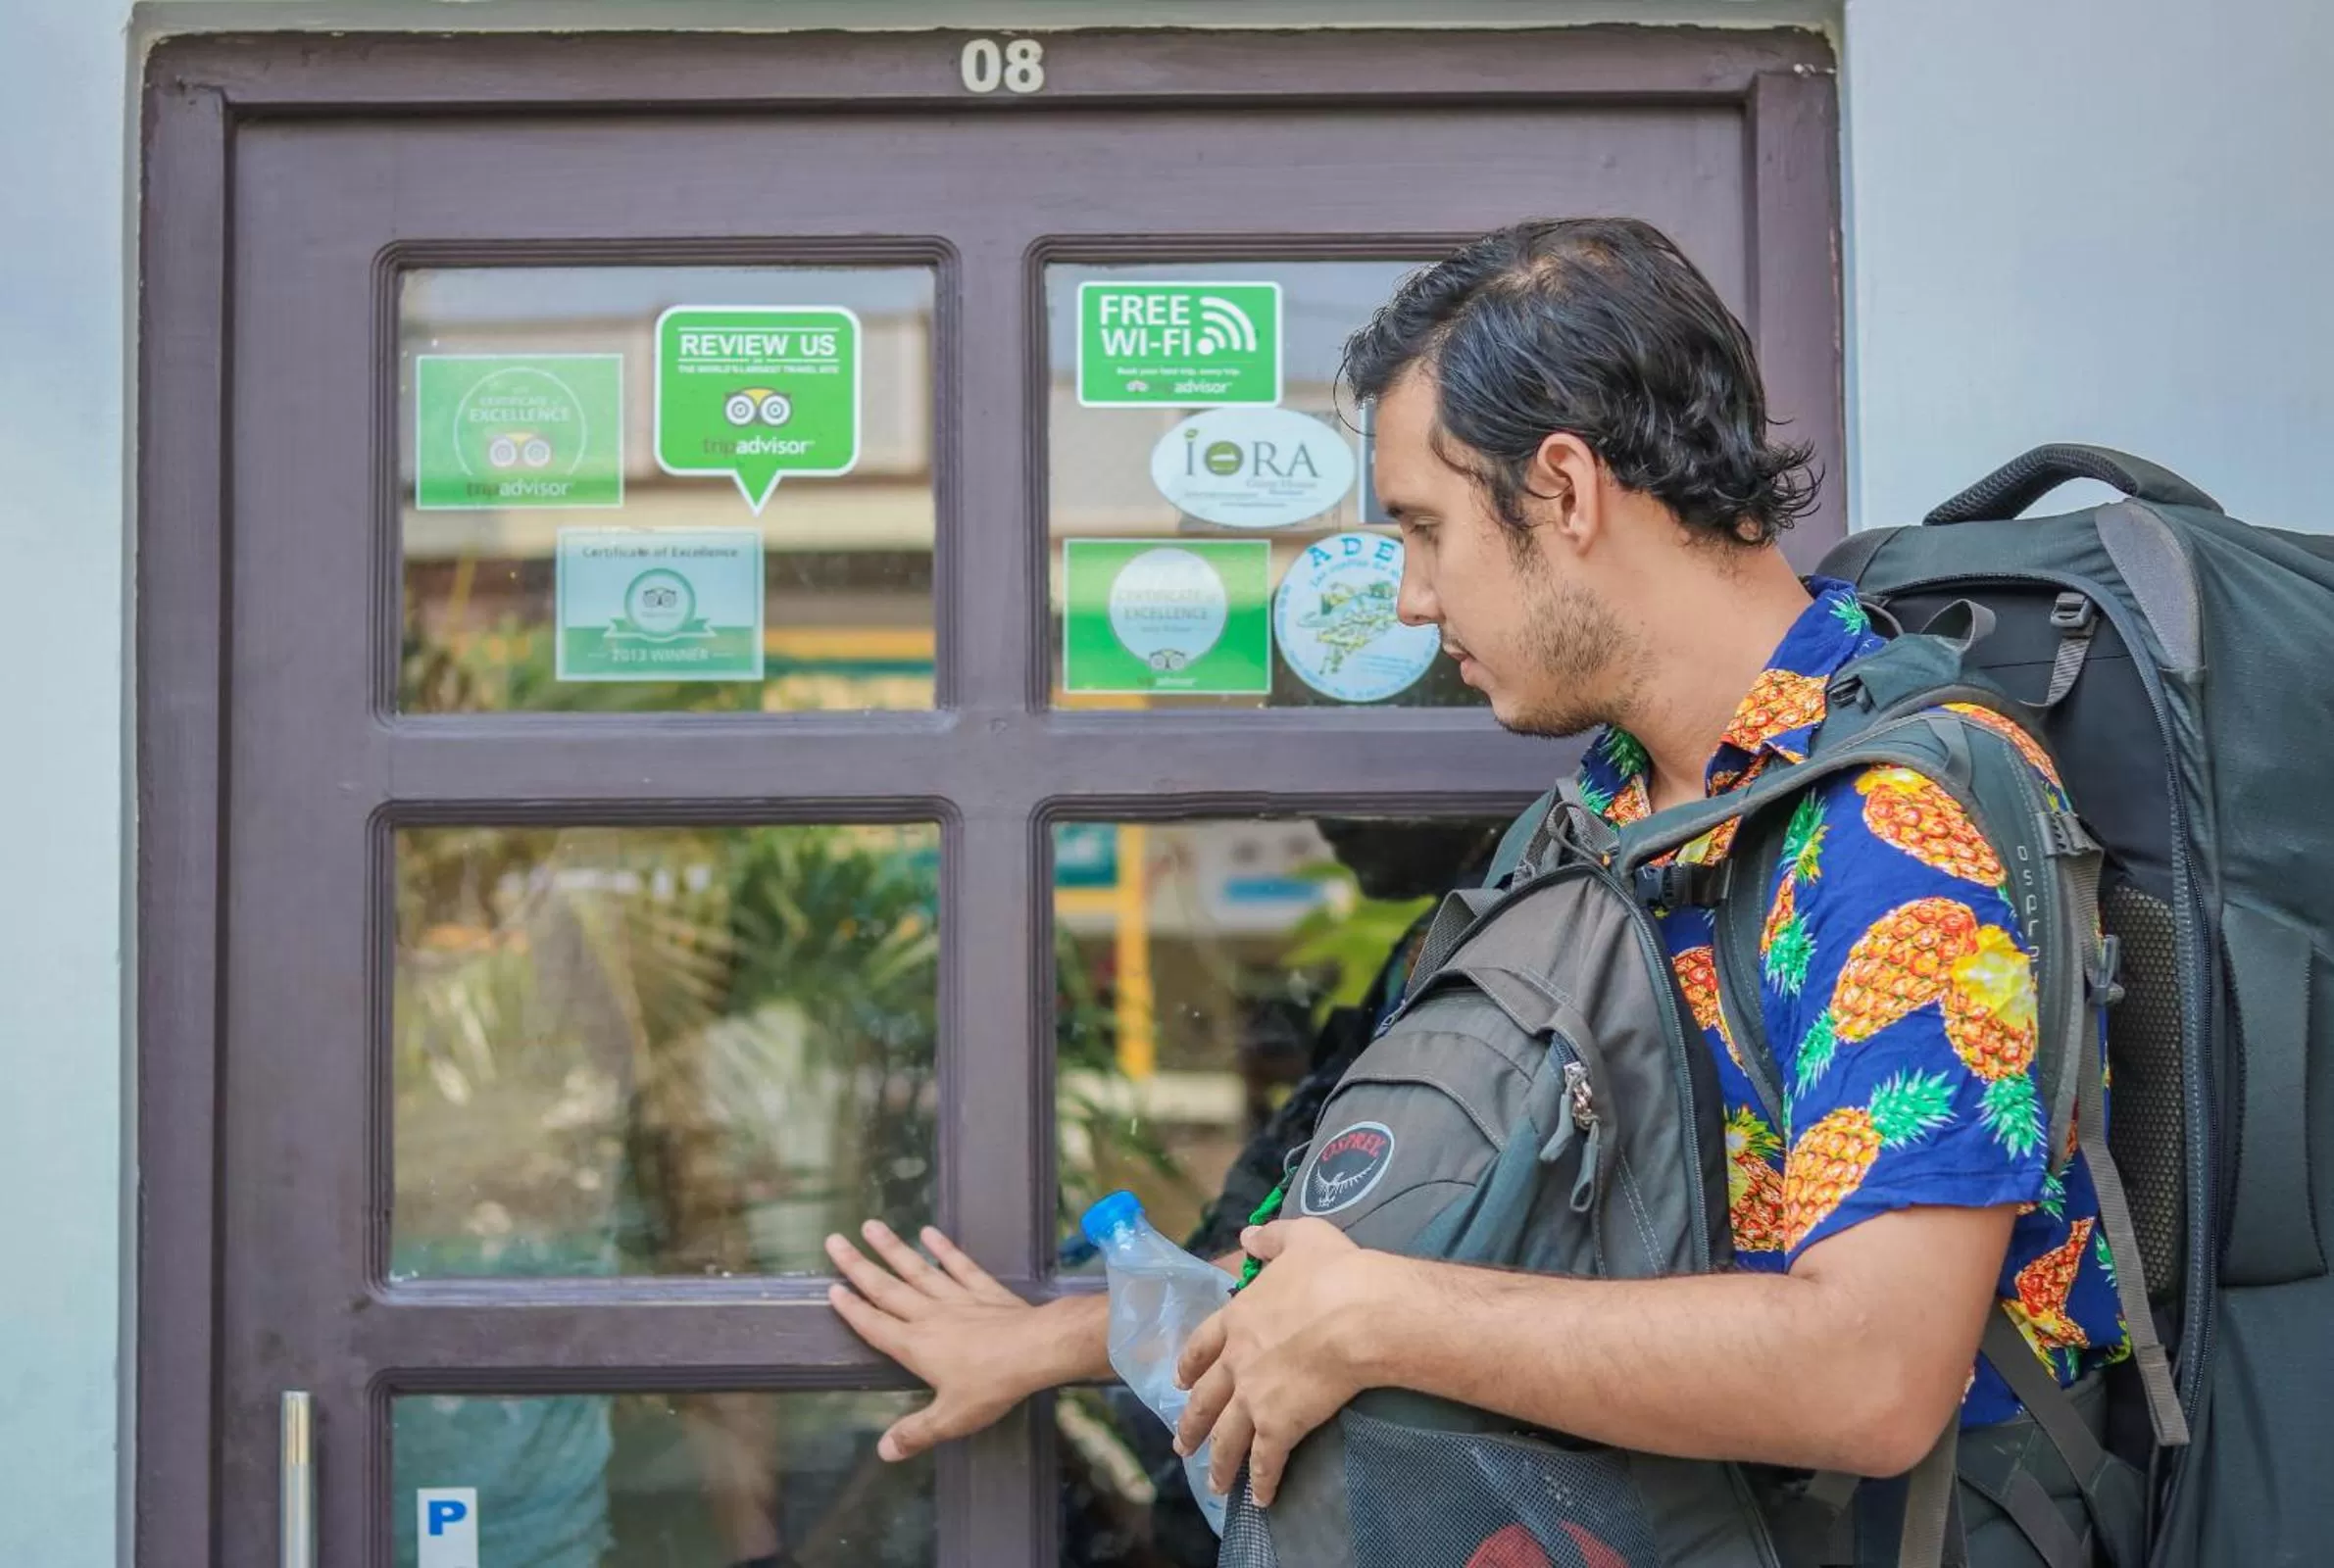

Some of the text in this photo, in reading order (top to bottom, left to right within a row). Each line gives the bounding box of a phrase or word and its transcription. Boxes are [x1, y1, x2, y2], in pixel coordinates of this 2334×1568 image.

[962, 38, 1045, 93] 08
[1100, 294, 1191, 325] FREE
[680, 334, 836, 356] REVIEW US
[1101, 327, 1192, 357] WI-FI
[1308, 537, 1397, 567] ADE
[428, 1499, 468, 1536] P
